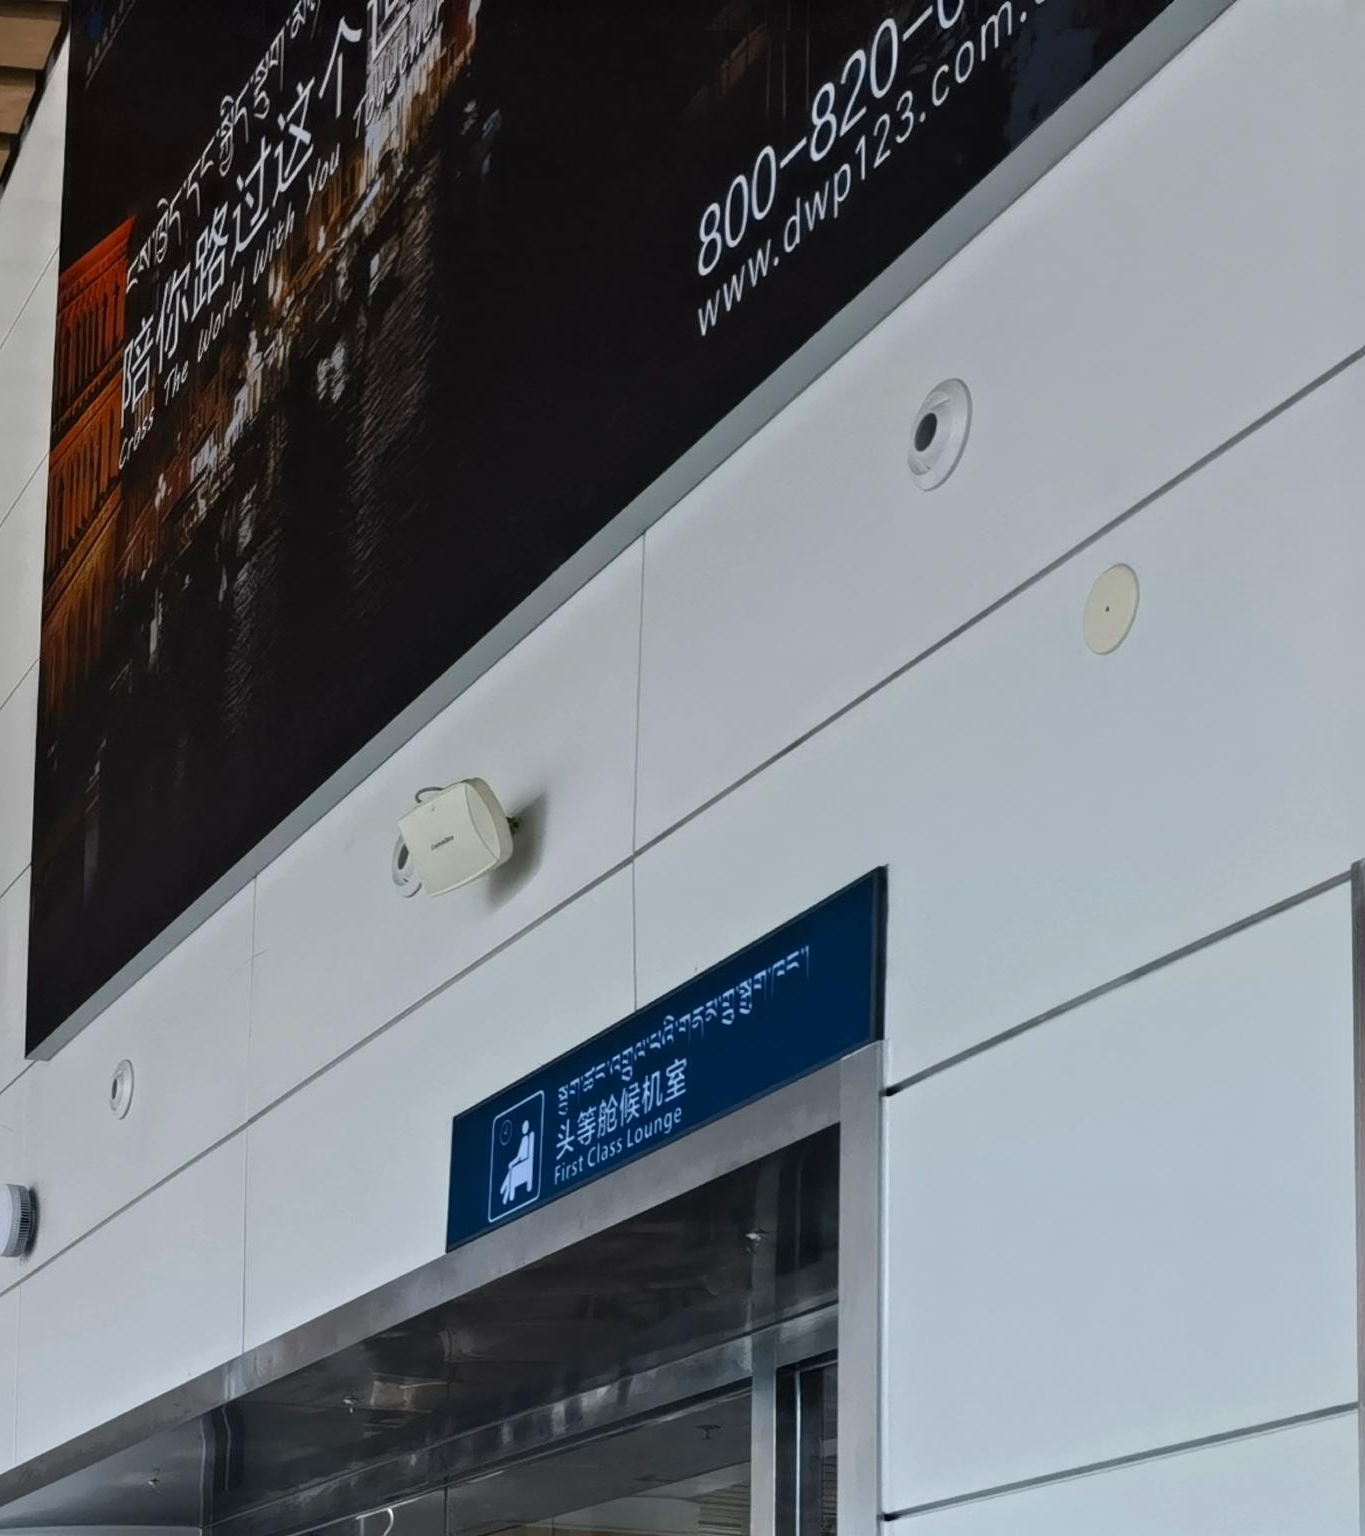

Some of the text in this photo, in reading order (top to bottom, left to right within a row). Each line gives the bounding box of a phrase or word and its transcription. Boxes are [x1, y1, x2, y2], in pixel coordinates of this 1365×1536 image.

[698, 0, 1045, 337] www.dwp123.com.
[119, 406, 155, 470] Cross
[164, 360, 189, 405] The
[197, 266, 246, 363] World
[252, 201, 295, 285] With
[307, 143, 341, 211] You
[554, 1106, 682, 1186] First Class Lounge
[556, 1058, 688, 1161] 头等舱候机室
